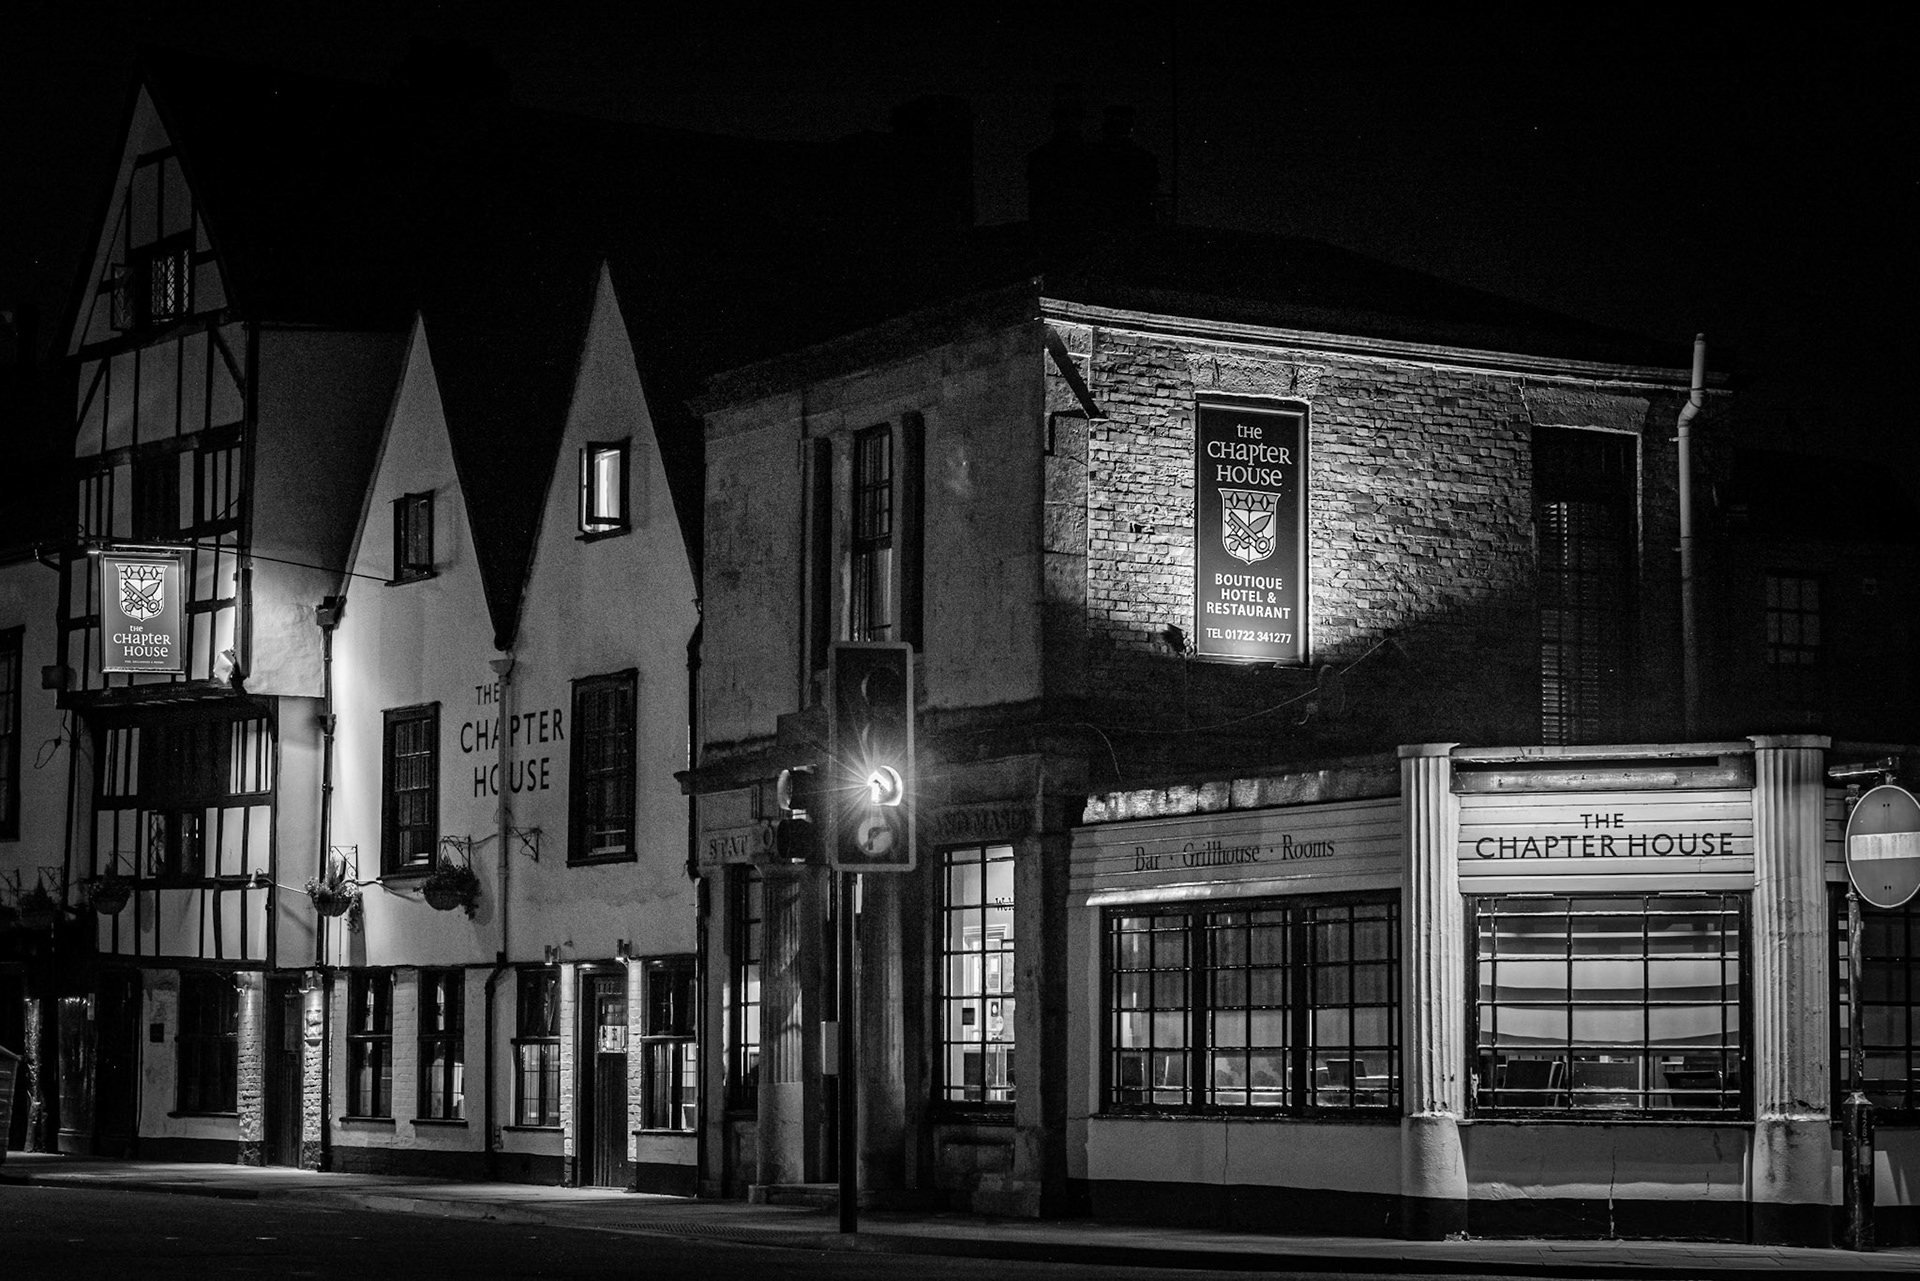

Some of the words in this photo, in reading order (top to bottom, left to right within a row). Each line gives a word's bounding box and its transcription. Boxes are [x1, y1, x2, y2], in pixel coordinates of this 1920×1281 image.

[1215, 573, 1283, 590] BOUTIQUE
[1221, 587, 1263, 603] HOTEL
[1267, 591, 1277, 603] &
[1206, 601, 1291, 619] RESTAURANT
[1206, 627, 1223, 639] TEL
[1225, 629, 1255, 642] 01722
[1257, 630, 1292, 644] 341277
[475, 682, 499, 705] THE
[1580, 813, 1624, 829] THE
[1134, 846, 1160, 871] Bar
[1183, 840, 1260, 868] Grillhouse
[1282, 834, 1335, 861] Rooms
[1475, 834, 1615, 859] CHAPTER
[1628, 832, 1734, 857] HOUSE
